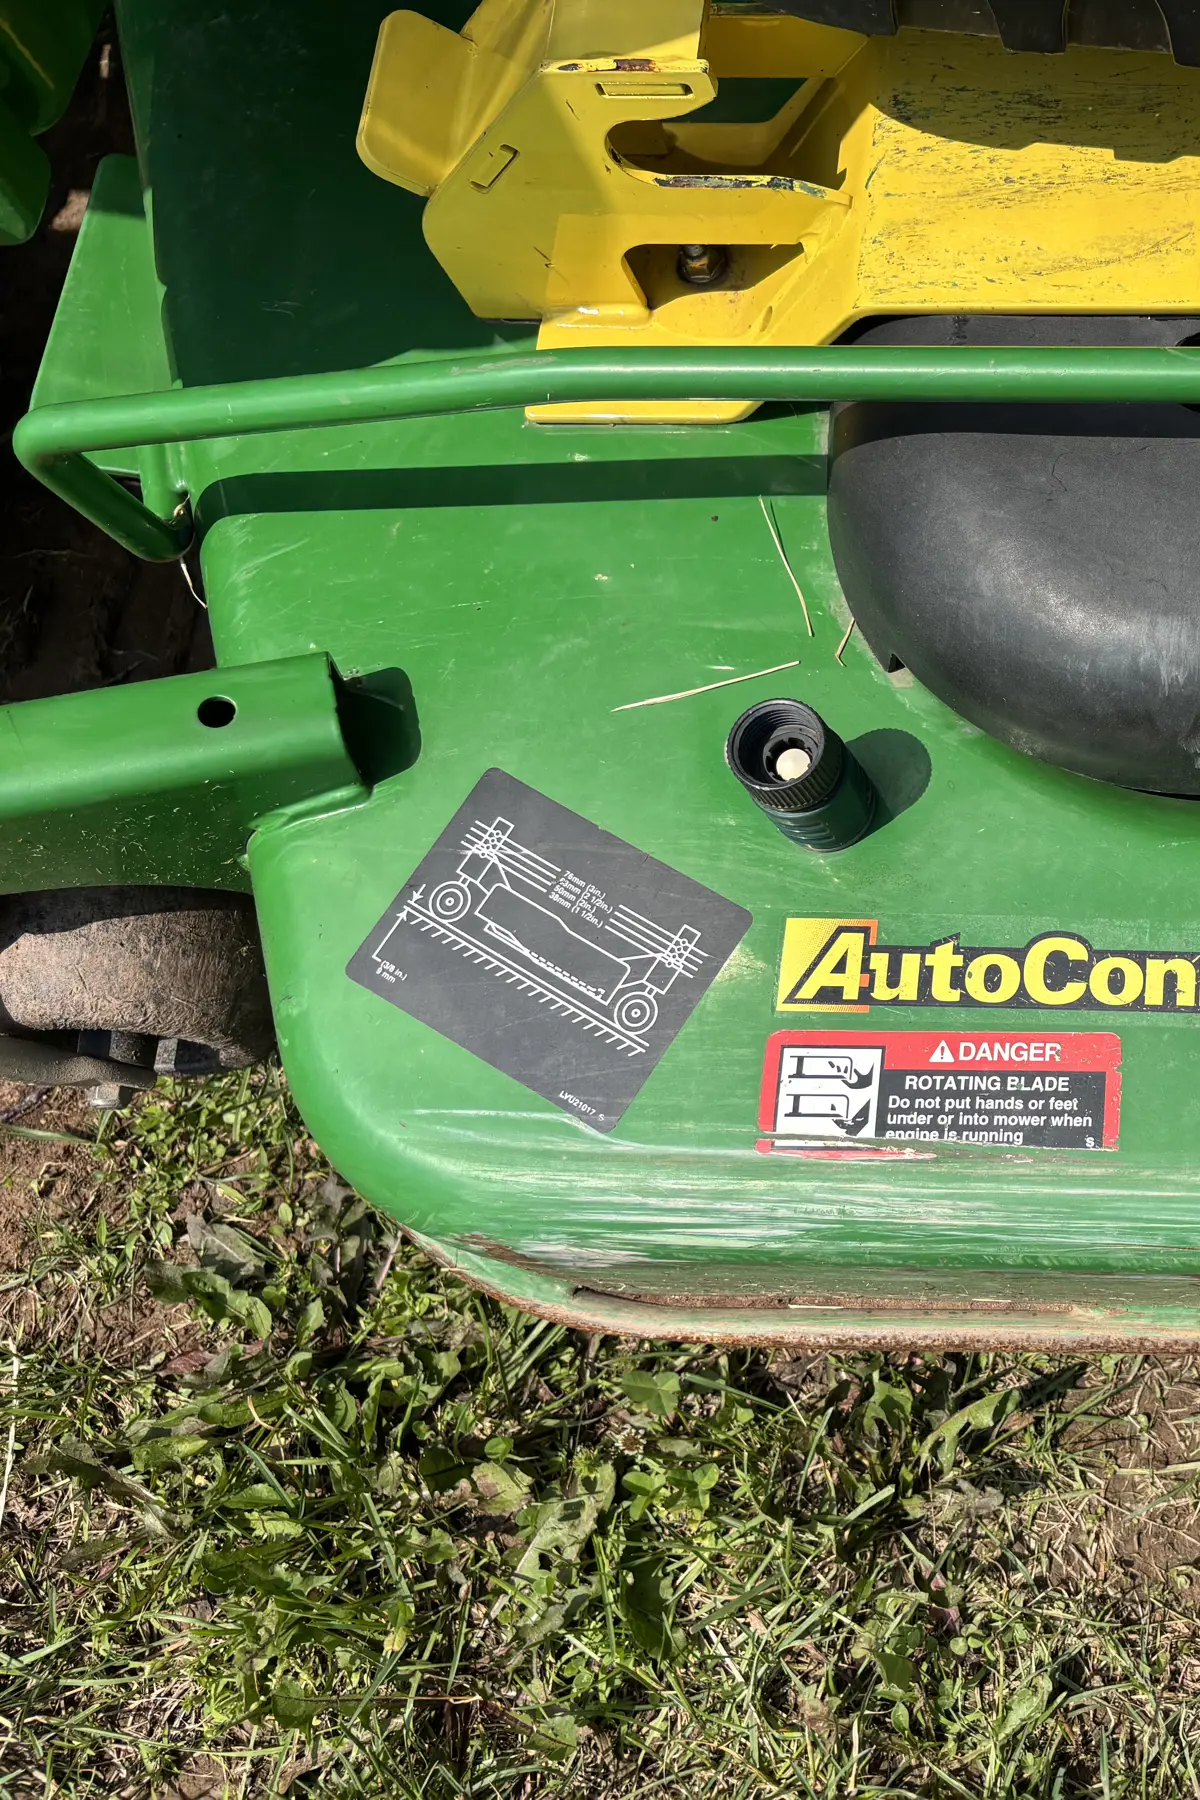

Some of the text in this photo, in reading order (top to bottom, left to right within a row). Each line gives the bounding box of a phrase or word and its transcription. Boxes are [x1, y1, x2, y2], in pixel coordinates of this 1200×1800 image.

[563, 870, 586, 888] 76mm
[548, 891, 572, 909] 38mm
[553, 885, 577, 902] 50mm
[375, 966, 396, 984] 9 mm
[959, 1042, 1061, 1062] DANGER
[904, 1075, 1070, 1092] ROTATING BLADE
[559, 1090, 597, 1116] LVU21017
[888, 1095, 1078, 1113] Do not put hands or feet
[887, 1111, 1092, 1127] under or into mower when
[885, 1128, 1024, 1146] engine is running
